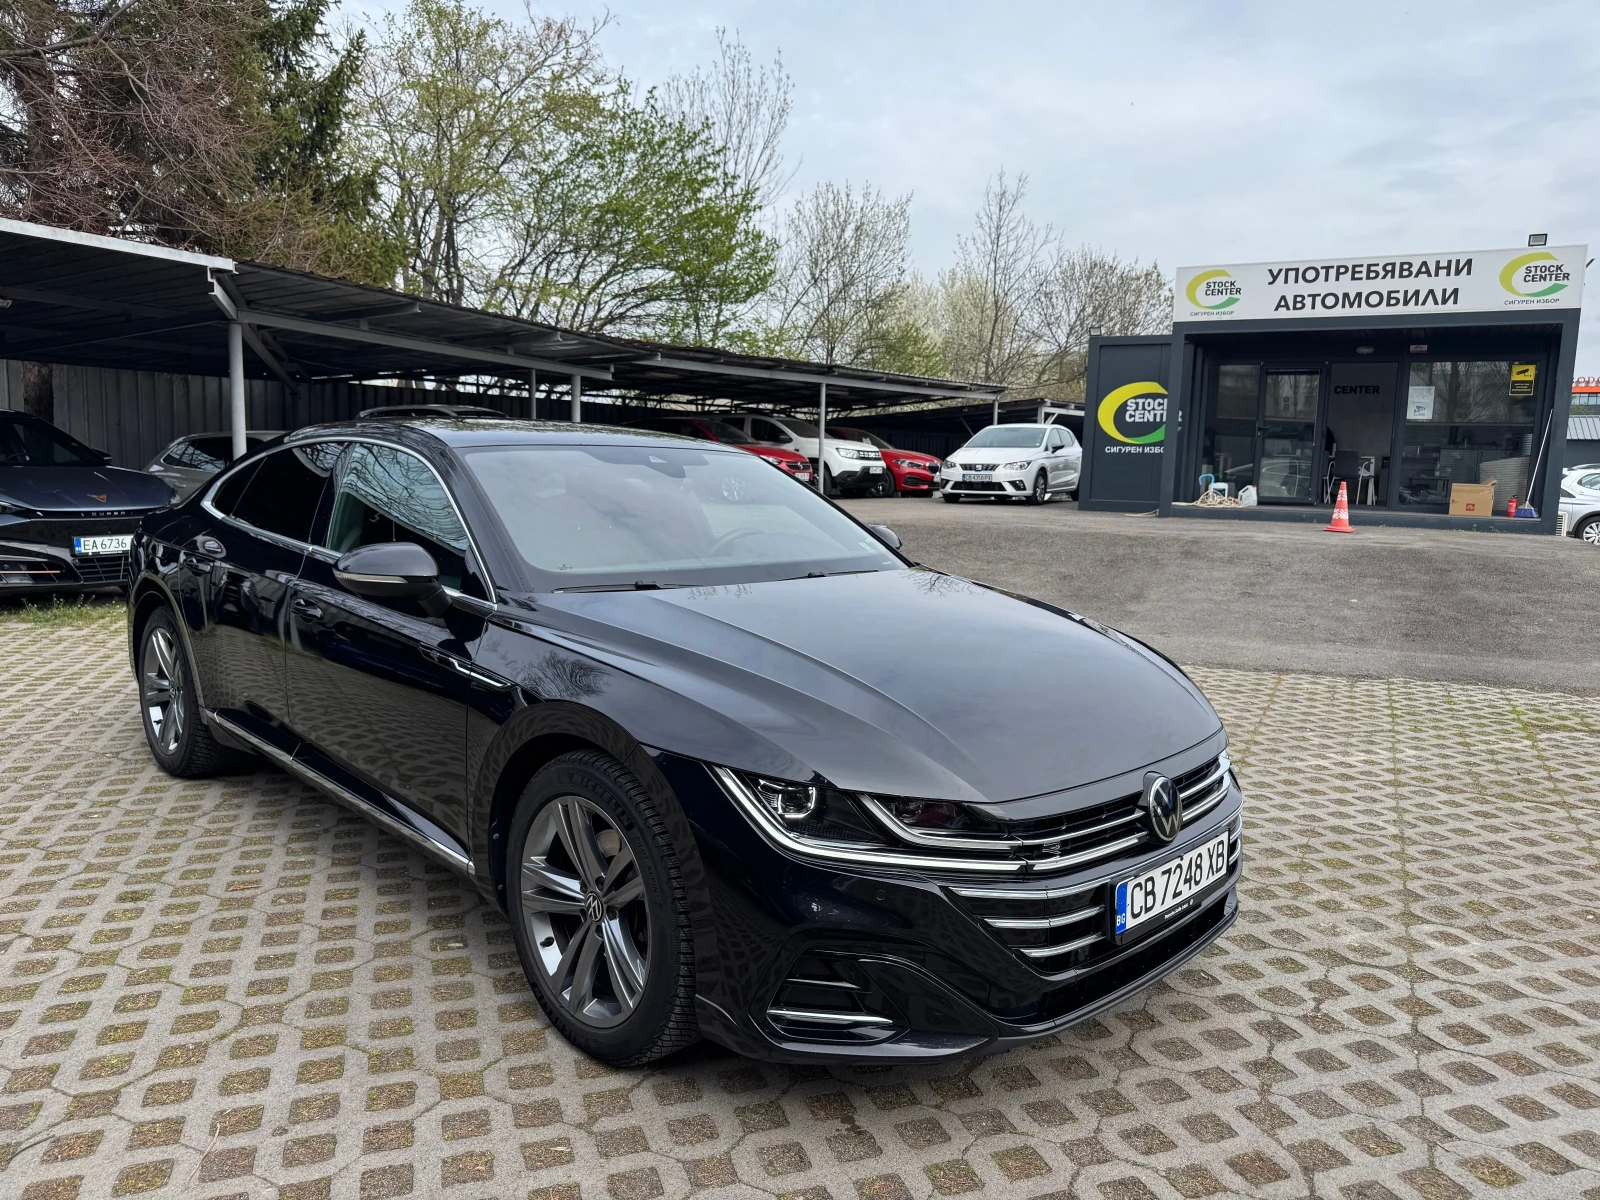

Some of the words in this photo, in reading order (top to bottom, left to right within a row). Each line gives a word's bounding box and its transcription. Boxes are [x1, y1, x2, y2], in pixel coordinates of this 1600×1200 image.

[1267, 258, 1473, 285] УПОТРЕБЯВАНИ
[1524, 263, 1564, 274] STOCK
[1523, 272, 1570, 283] CENTER
[1205, 280, 1237, 289] STOCK
[1204, 287, 1242, 297] CENTER
[1273, 287, 1460, 312] АВТОМОБИЛИ
[1333, 385, 1381, 395] CENTER
[1105, 446, 1143, 454] СИГУРЕН
[83, 539, 98, 550] EA
[100, 538, 127, 550] 6736
[1130, 875, 1156, 920] CB
[1160, 852, 1203, 906] 7248
[1206, 839, 1225, 880] XB
[1116, 912, 1126, 926] BG
